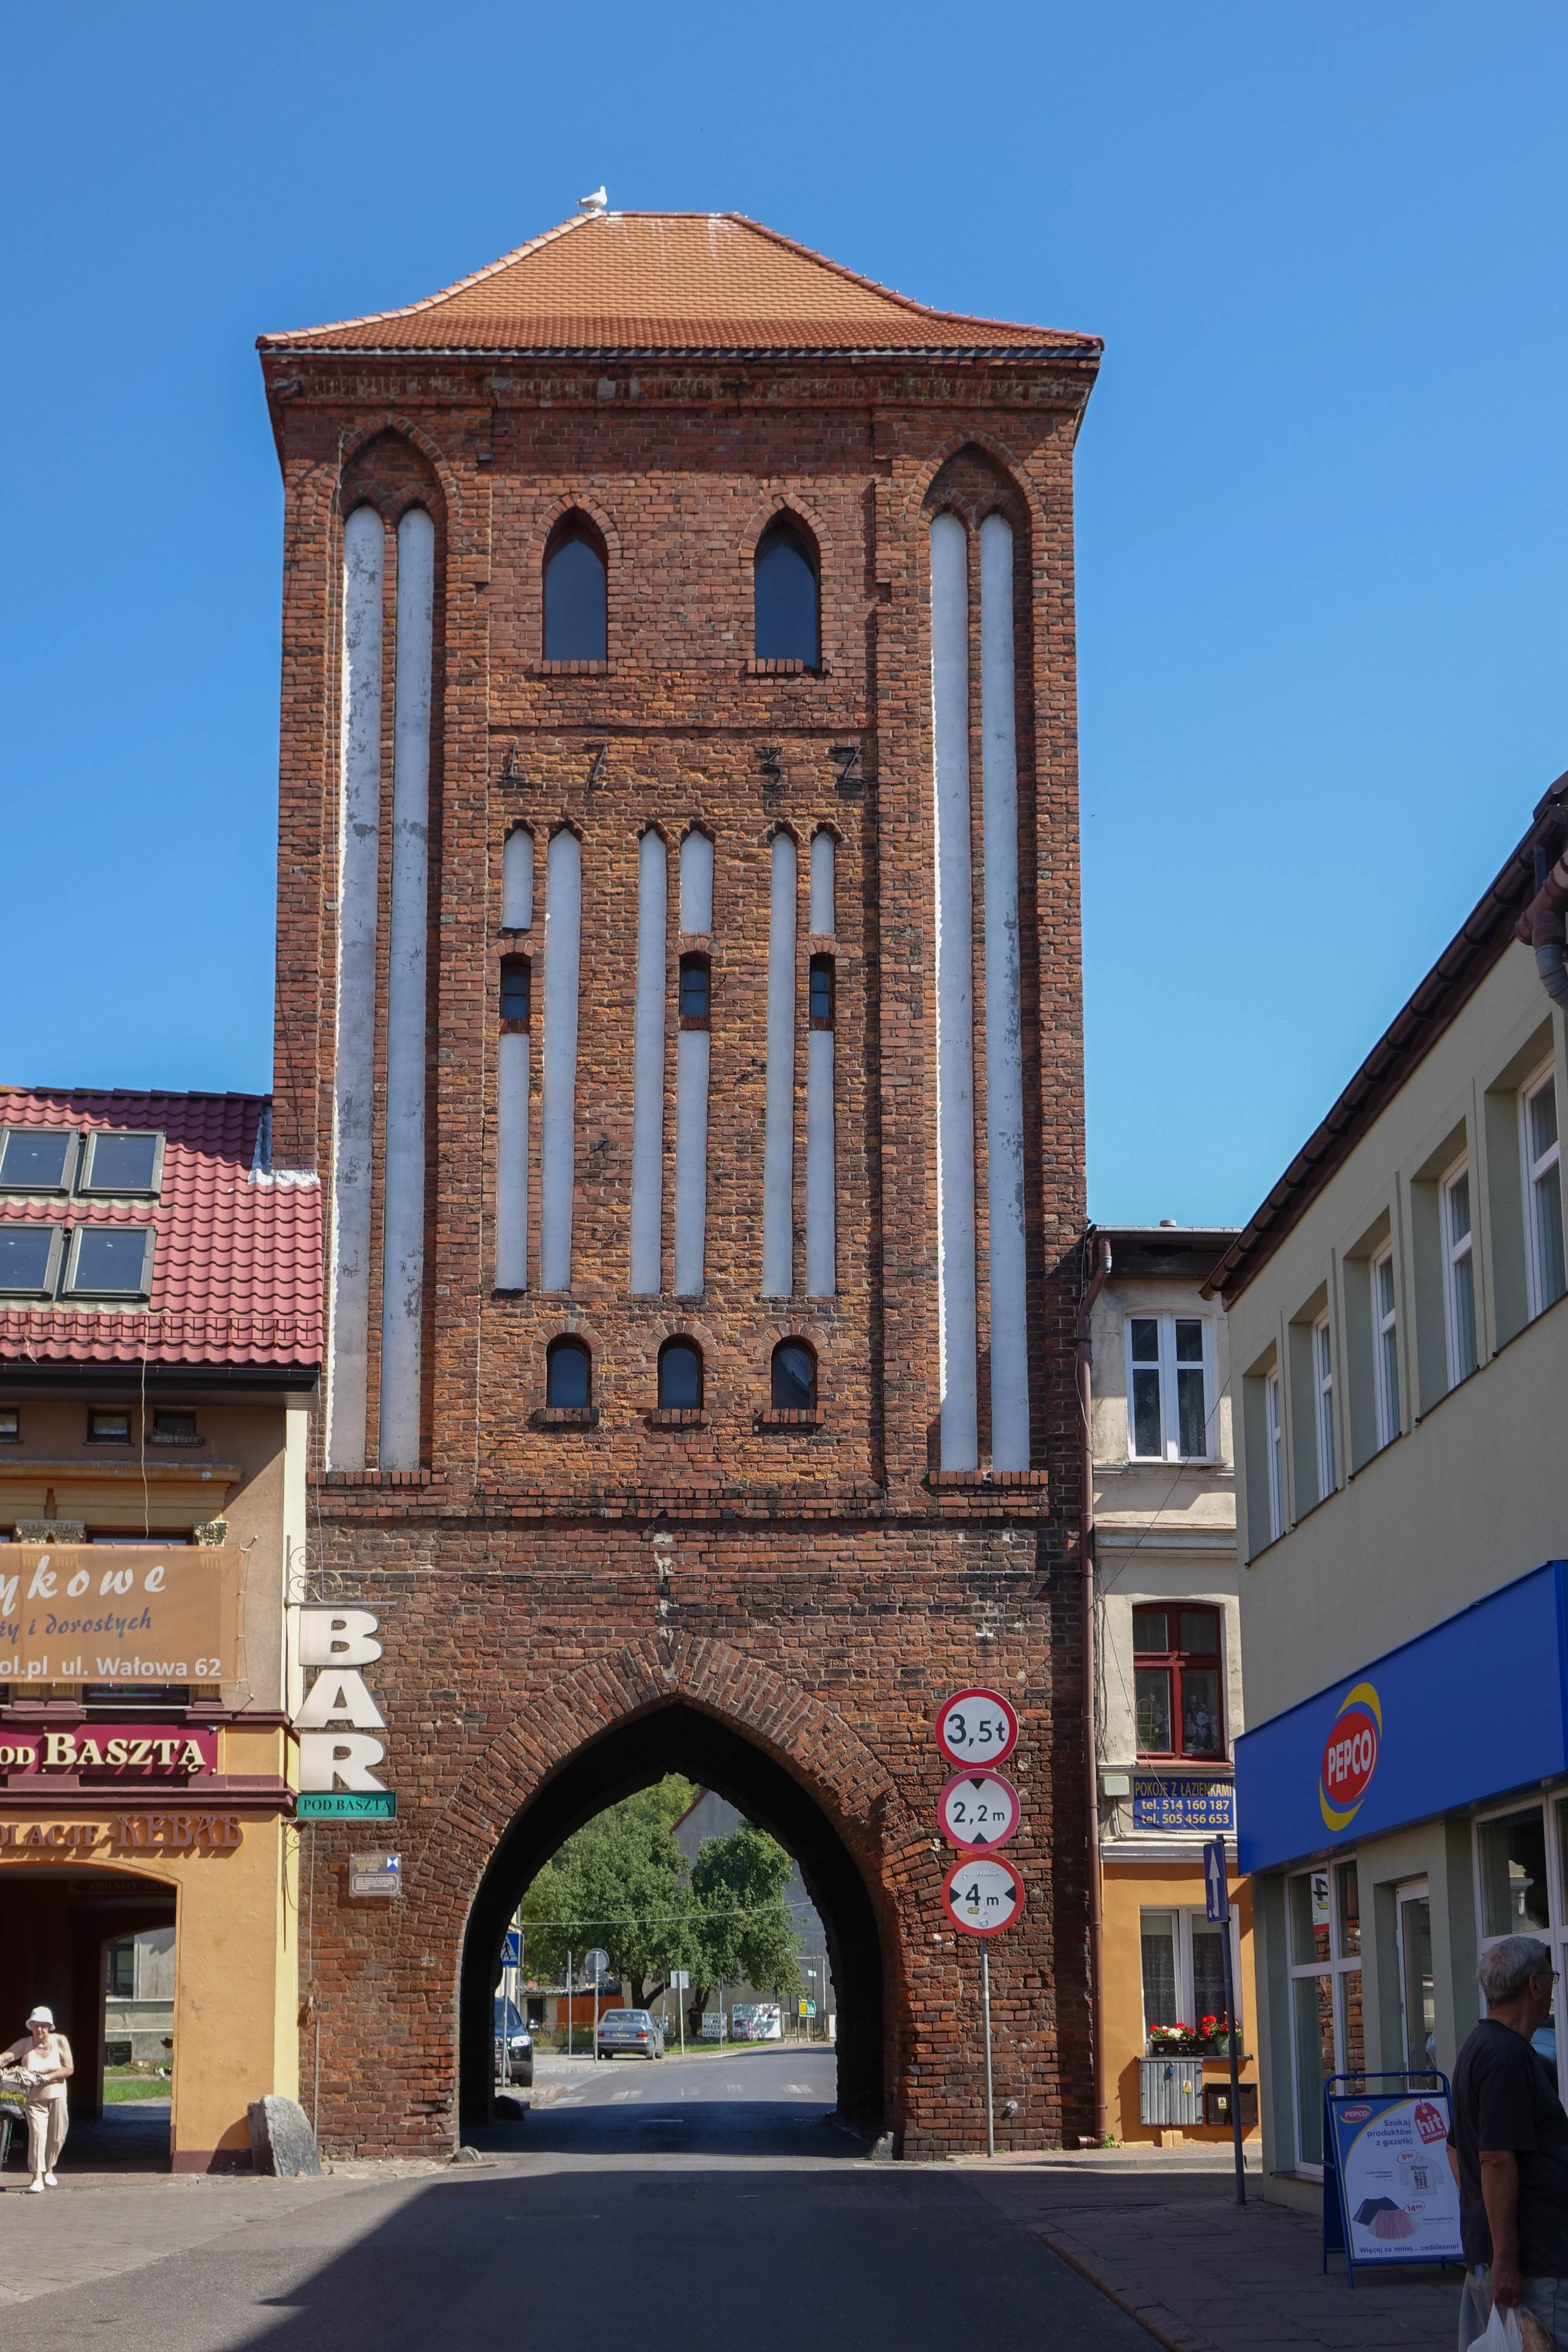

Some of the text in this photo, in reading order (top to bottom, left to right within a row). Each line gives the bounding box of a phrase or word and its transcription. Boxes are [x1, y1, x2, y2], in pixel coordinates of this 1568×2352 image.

[28, 1619, 36, 1635] i
[45, 1607, 151, 1638] dorosłych
[62, 1656, 88, 1676] ul.
[97, 1656, 187, 1676] Wałowa
[195, 1658, 221, 1676] 62
[292, 1606, 389, 1791] BAR
[43, 1733, 206, 1772] BASZTĄ
[1328, 1729, 1371, 1786] PEPCO
[1135, 1781, 1232, 1797] POKOJE Z ŁAZIENKAMI
[304, 1799, 332, 1811] POD
[1142, 1799, 1229, 1810] tel. 514 160 187
[1142, 1813, 1229, 1824] tel. 505 456 653
[1384, 2118, 1411, 2128] Szukaj
[1416, 2114, 1442, 2135] hit
[1367, 2128, 1412, 2138] produktów
[1422, 2130, 1446, 2140] cenowy
[1383, 2138, 1413, 2148] gazetki
